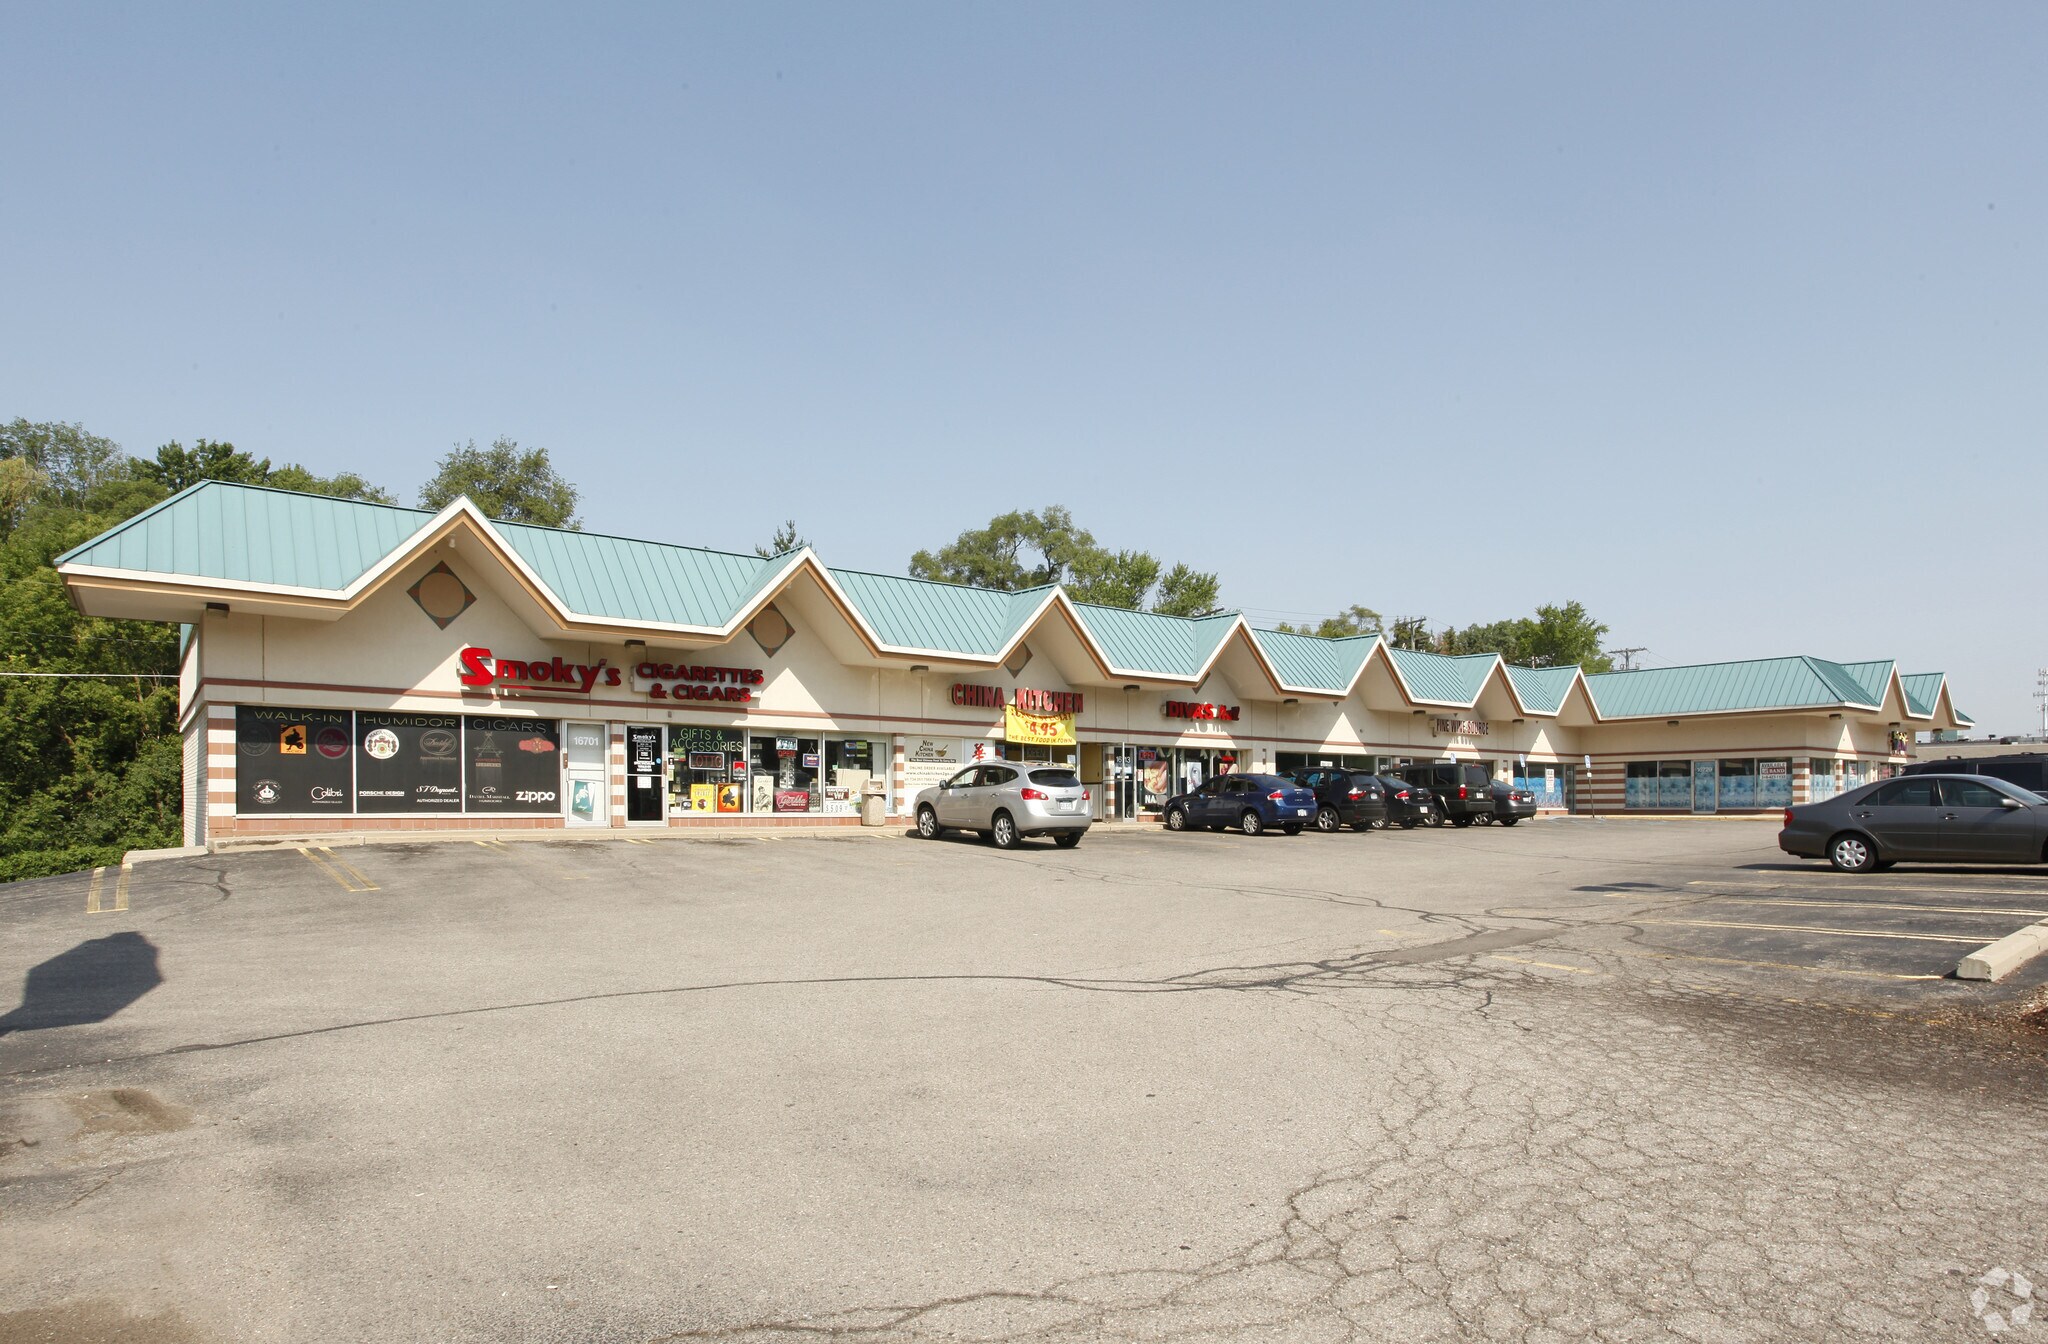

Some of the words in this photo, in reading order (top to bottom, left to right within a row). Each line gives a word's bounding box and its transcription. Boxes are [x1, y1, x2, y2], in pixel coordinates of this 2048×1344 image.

[460, 647, 622, 693] Smoky's
[636, 662, 764, 685] CIGARETTES
[650, 683, 668, 699] &
[672, 684, 753, 702] CIGARS
[952, 683, 1006, 709] CHINA
[1015, 687, 1084, 713] KITCHEN
[254, 711, 343, 723] WALK-IN
[1166, 701, 1215, 720] DIVA'S
[363, 716, 457, 727] HUMIDOR
[472, 719, 547, 734] CIGARS
[1436, 719, 1450, 732] FINE
[1450, 720, 1467, 734] WINE
[1467, 720, 1489, 735] SOURCE
[574, 736, 600, 746] 16701
[680, 728, 712, 740] GIFTS
[716, 730, 723, 740] &
[671, 738, 744, 752] ACCESSORIES
[691, 755, 723, 768] LOTTO
[311, 786, 344, 800] Colibri
[515, 791, 556, 803] zippo
